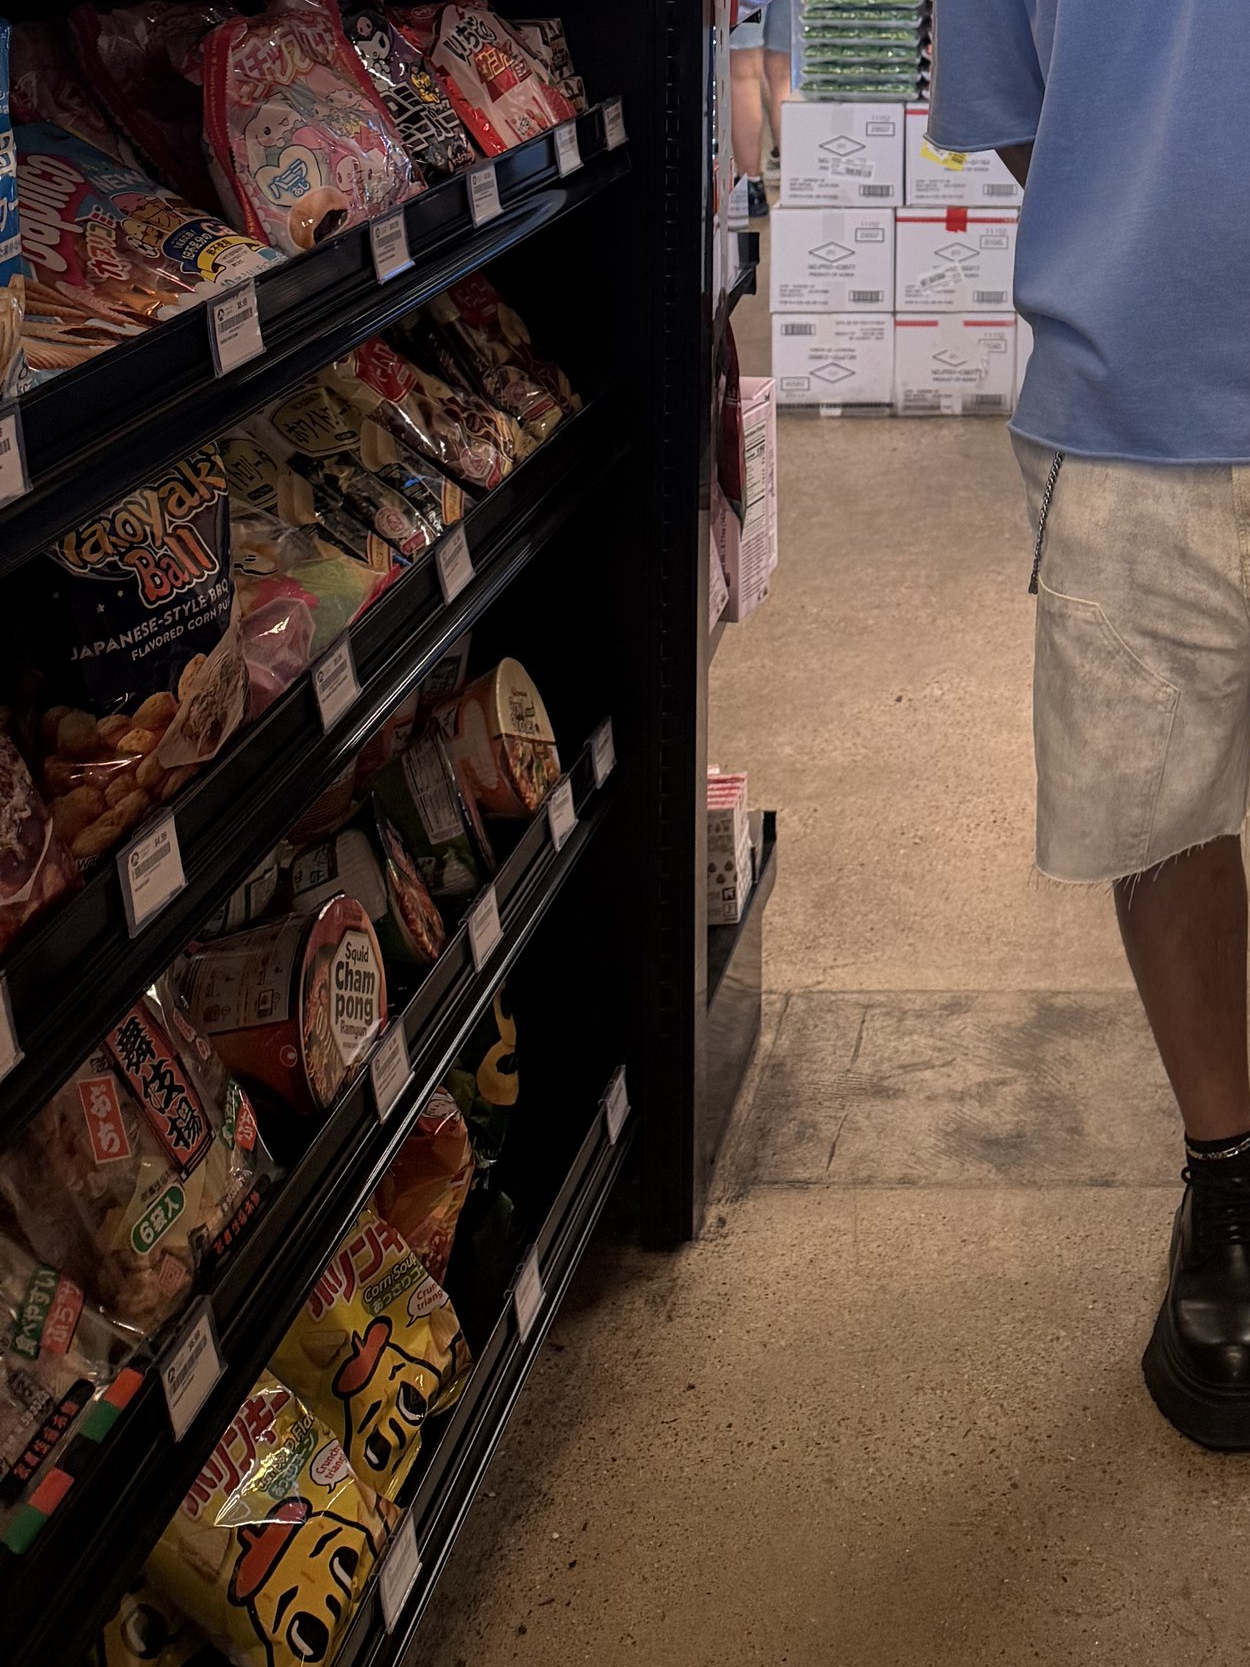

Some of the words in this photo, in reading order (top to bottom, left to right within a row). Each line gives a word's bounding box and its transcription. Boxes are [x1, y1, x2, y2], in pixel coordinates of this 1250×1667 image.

[122, 525, 218, 605] Ball
[70, 594, 207, 662] JAPANESE-STYLE
[208, 577, 229, 603] BBQ
[130, 625, 185, 662] FLAVORED
[187, 608, 217, 630] CORN
[345, 941, 369, 966] Squid
[335, 960, 375, 996] Cham
[335, 993, 374, 1027] pong
[363, 1274, 393, 1304] Corn
